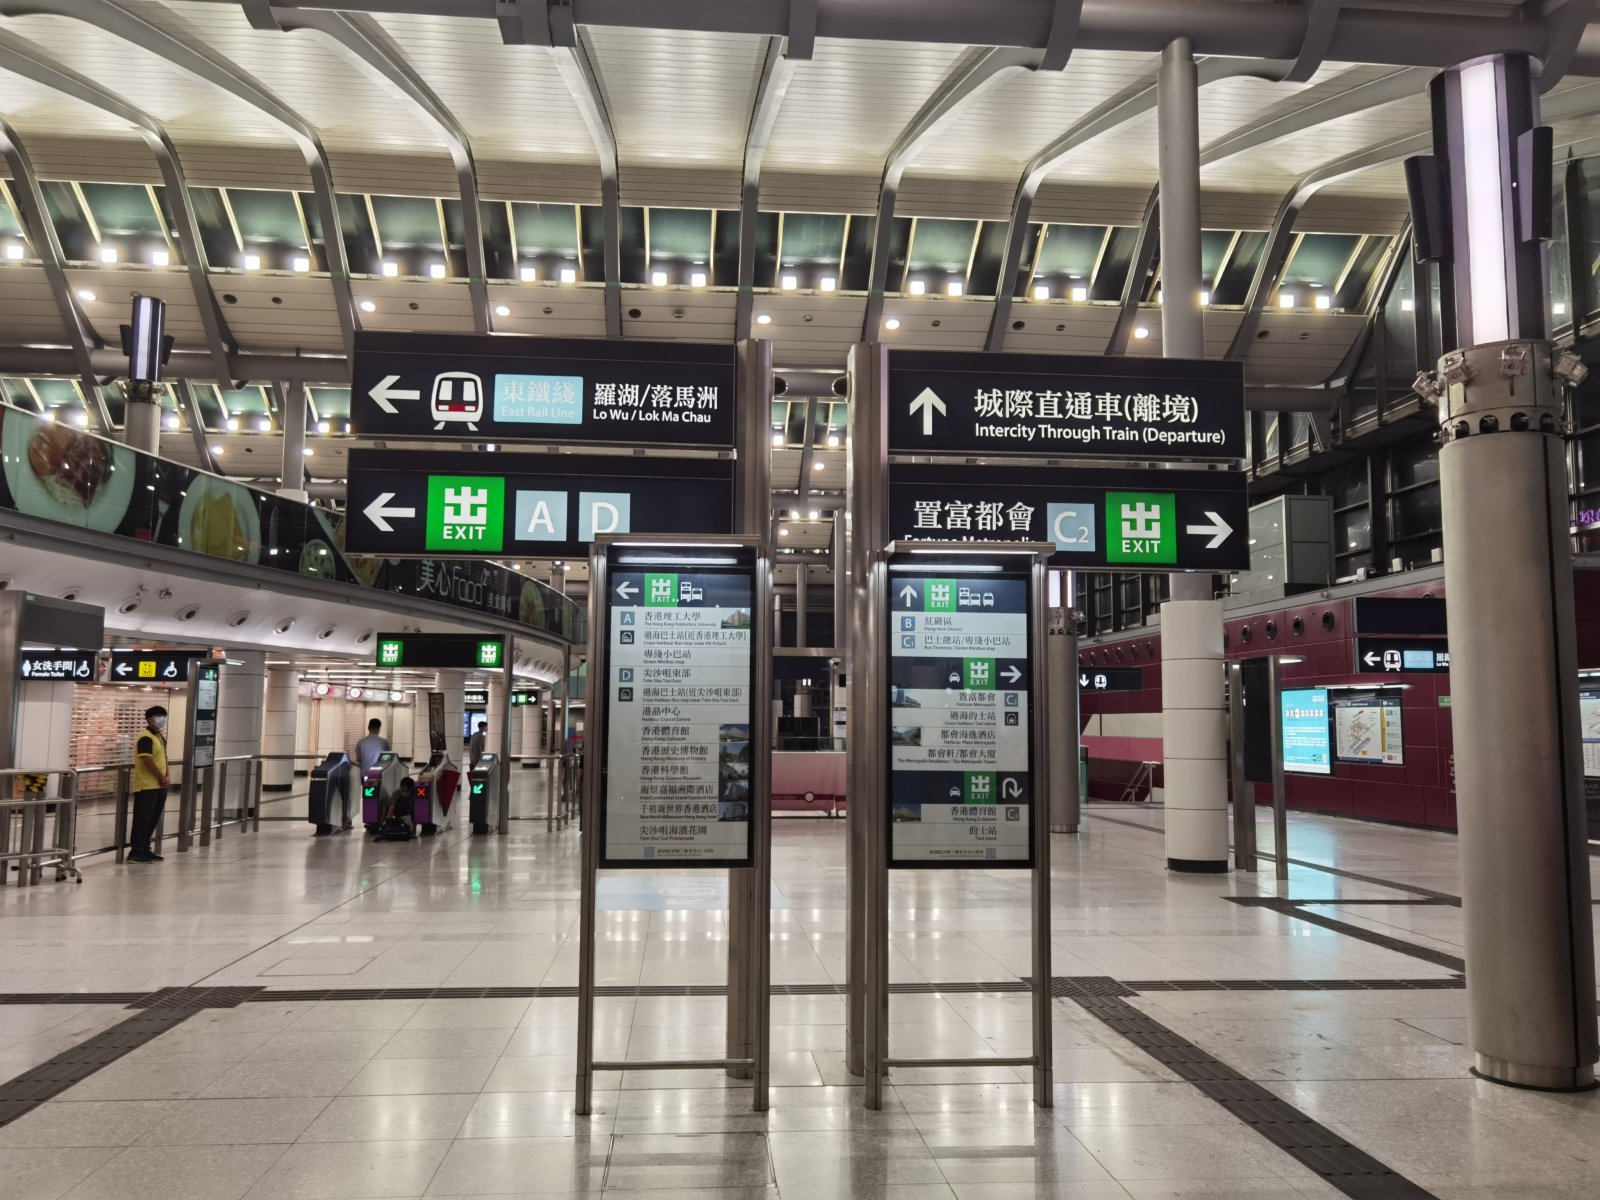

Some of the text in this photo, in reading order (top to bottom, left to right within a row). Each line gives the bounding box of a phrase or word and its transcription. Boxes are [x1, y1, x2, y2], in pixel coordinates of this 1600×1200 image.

[503, 380, 575, 405] 東鐵綫
[594, 382, 718, 411] 羅湖/落馬洲
[501, 405, 576, 419] East Rail Line
[973, 388, 1199, 425] 城際直通車(離境)
[593, 409, 712, 424] Lo Wu / Lok Ma Chau
[974, 422, 1226, 446] Intercity Through Train (Departure)
[527, 500, 555, 534] A
[591, 502, 620, 534] D
[913, 500, 1035, 532] 置富都會
[443, 526, 486, 540] EXIT
[1053, 511, 1089, 545] C2
[1121, 540, 1161, 554] EXIT
[651, 595, 670, 603] EXIT
[623, 613, 632, 624] A
[645, 611, 701, 621] 香港理工大學
[905, 618, 912, 629] B
[32, 660, 73, 671] 女洗手間
[622, 670, 631, 681] D
